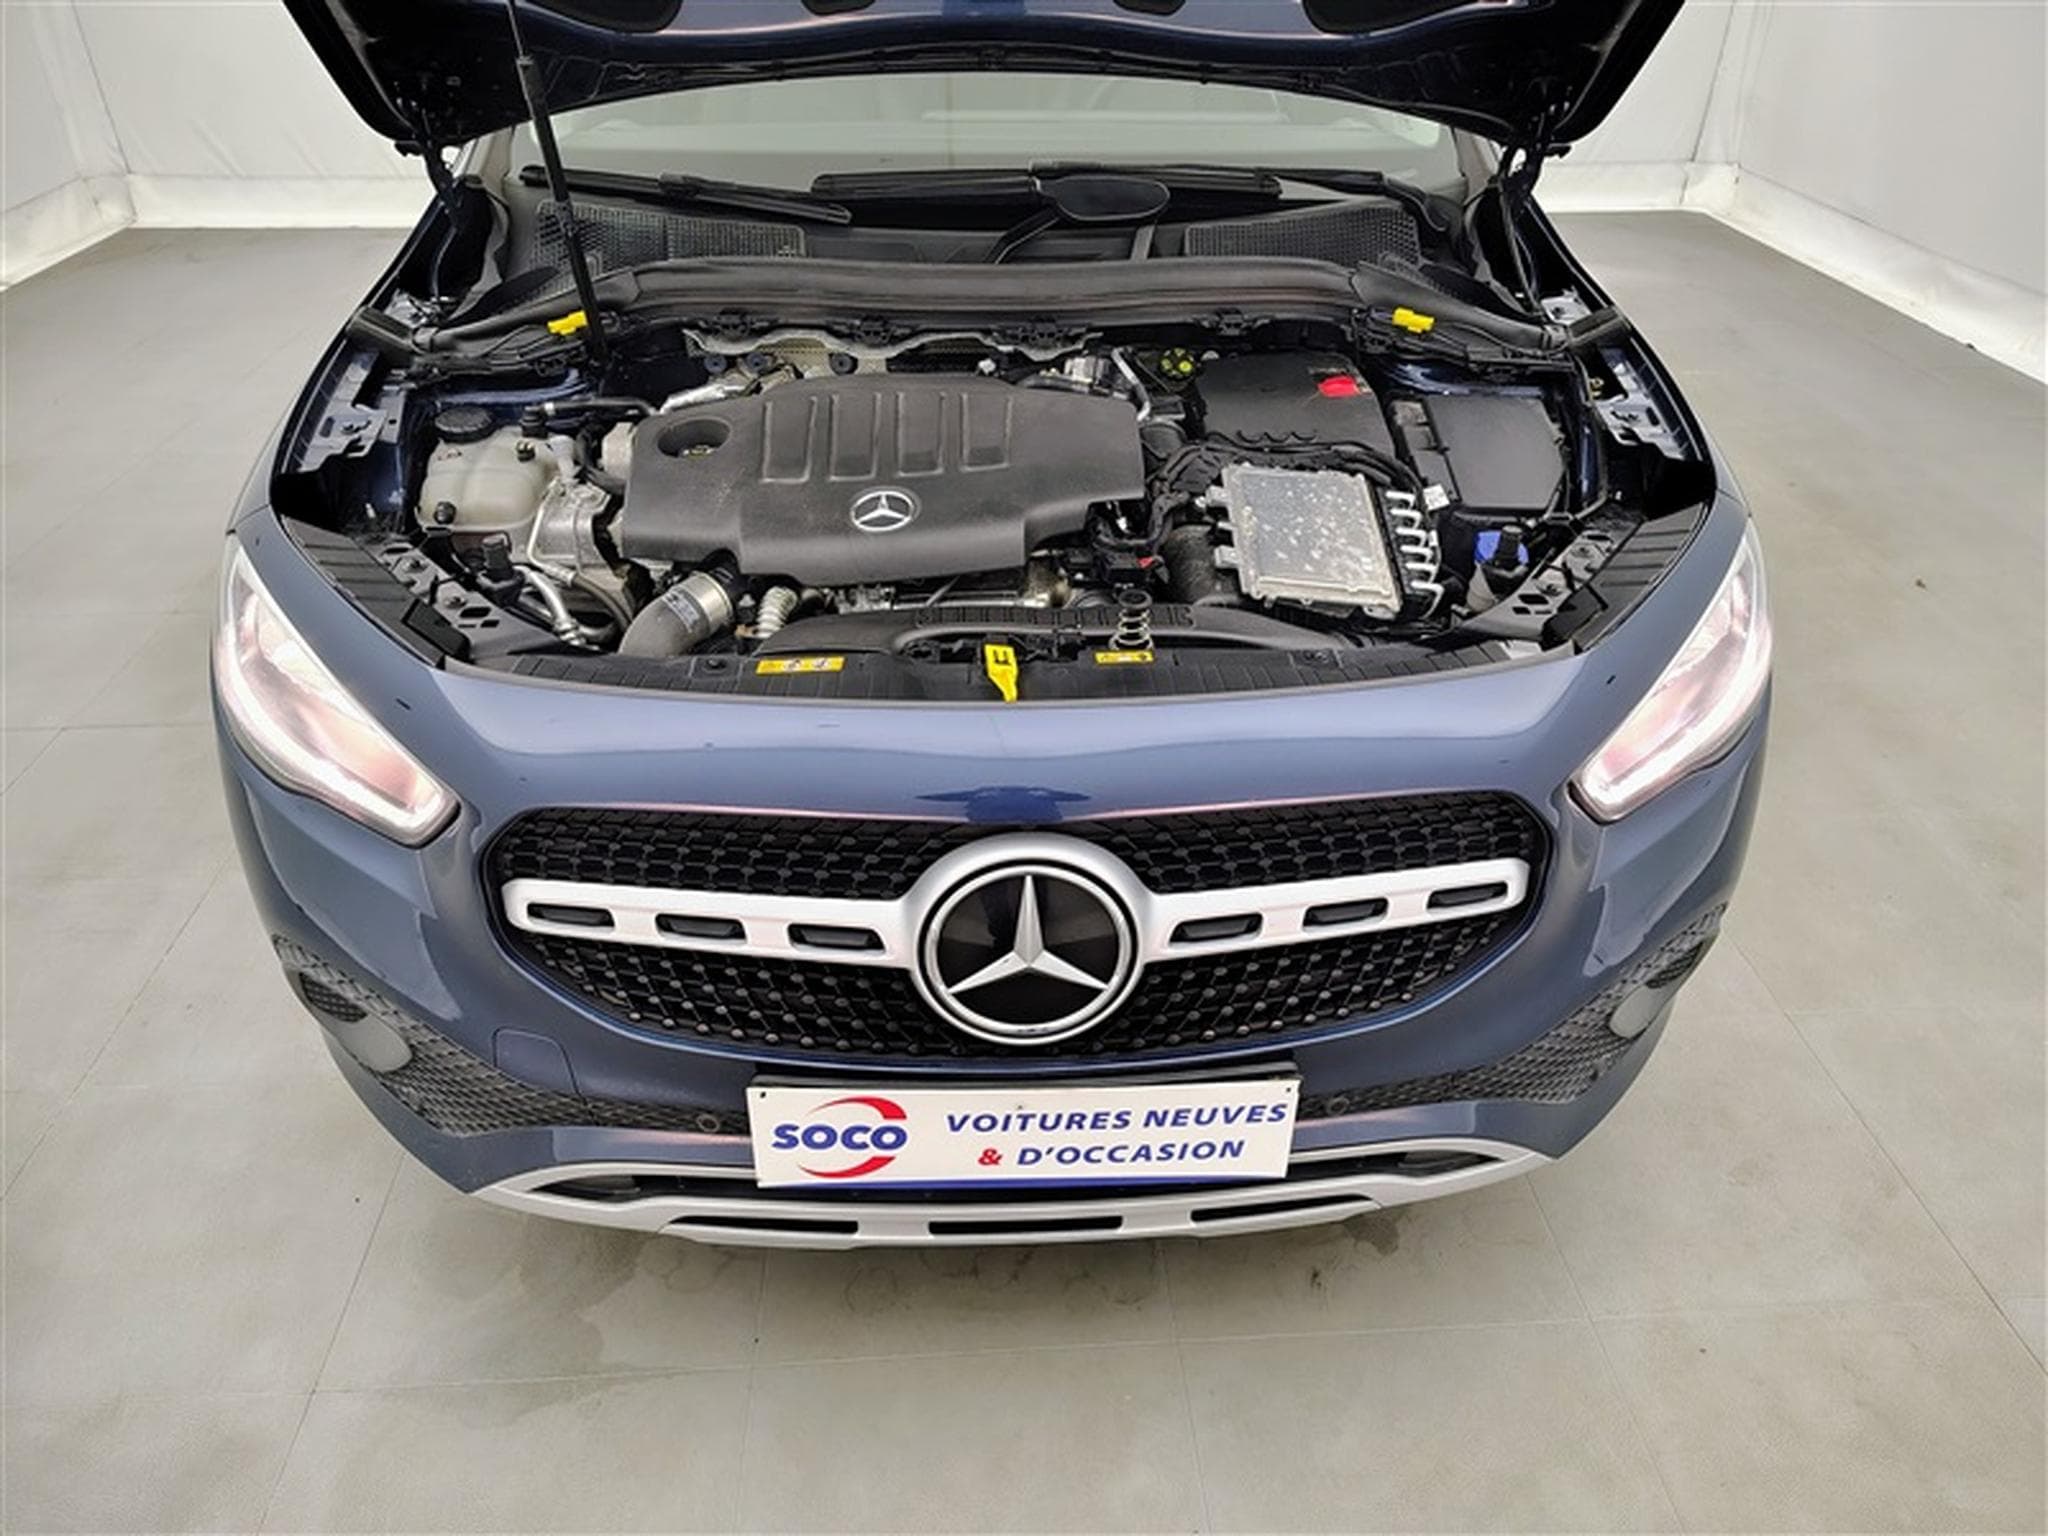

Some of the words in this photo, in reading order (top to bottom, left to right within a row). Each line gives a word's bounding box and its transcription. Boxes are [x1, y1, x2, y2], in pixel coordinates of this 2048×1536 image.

[946, 1111, 1131, 1133] VOITURES
[1142, 1104, 1288, 1129] NEUVES
[772, 1123, 908, 1152] SOCO
[977, 1147, 1002, 1167] &
[1017, 1140, 1245, 1166] D'OCCASION
